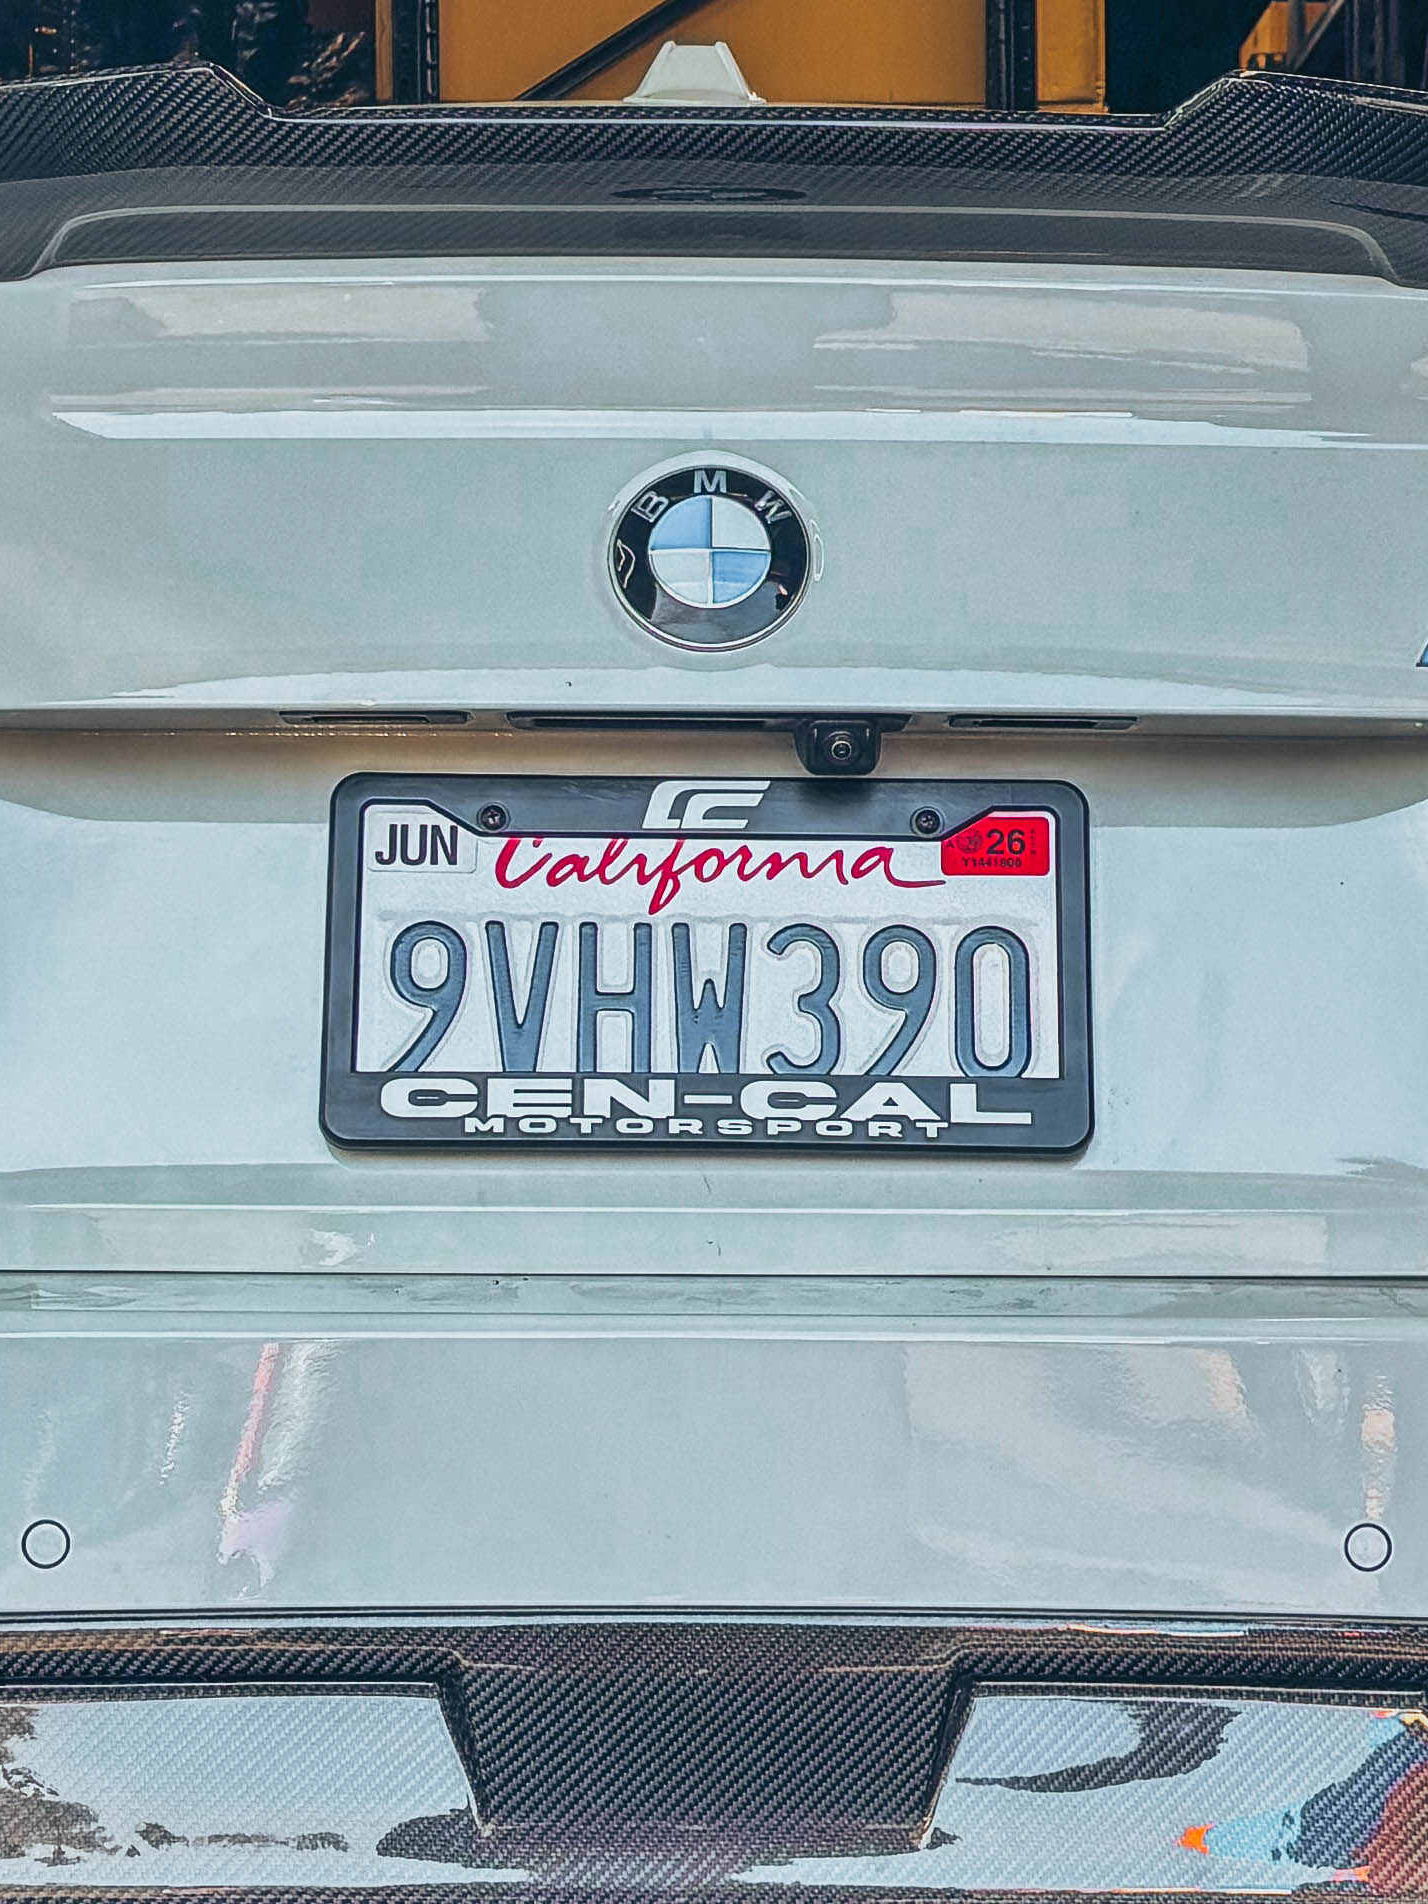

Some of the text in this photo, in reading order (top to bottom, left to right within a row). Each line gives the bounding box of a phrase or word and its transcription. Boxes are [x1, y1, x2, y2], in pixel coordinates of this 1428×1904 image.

[631, 470, 792, 524] BMW
[375, 823, 459, 866] JUN
[985, 828, 1026, 855] 26
[494, 837, 946, 915] California
[388, 920, 1032, 1077] 9VHW390
[380, 1077, 1033, 1125] CEN-CAL
[463, 1116, 949, 1139] MOTORSPORT
